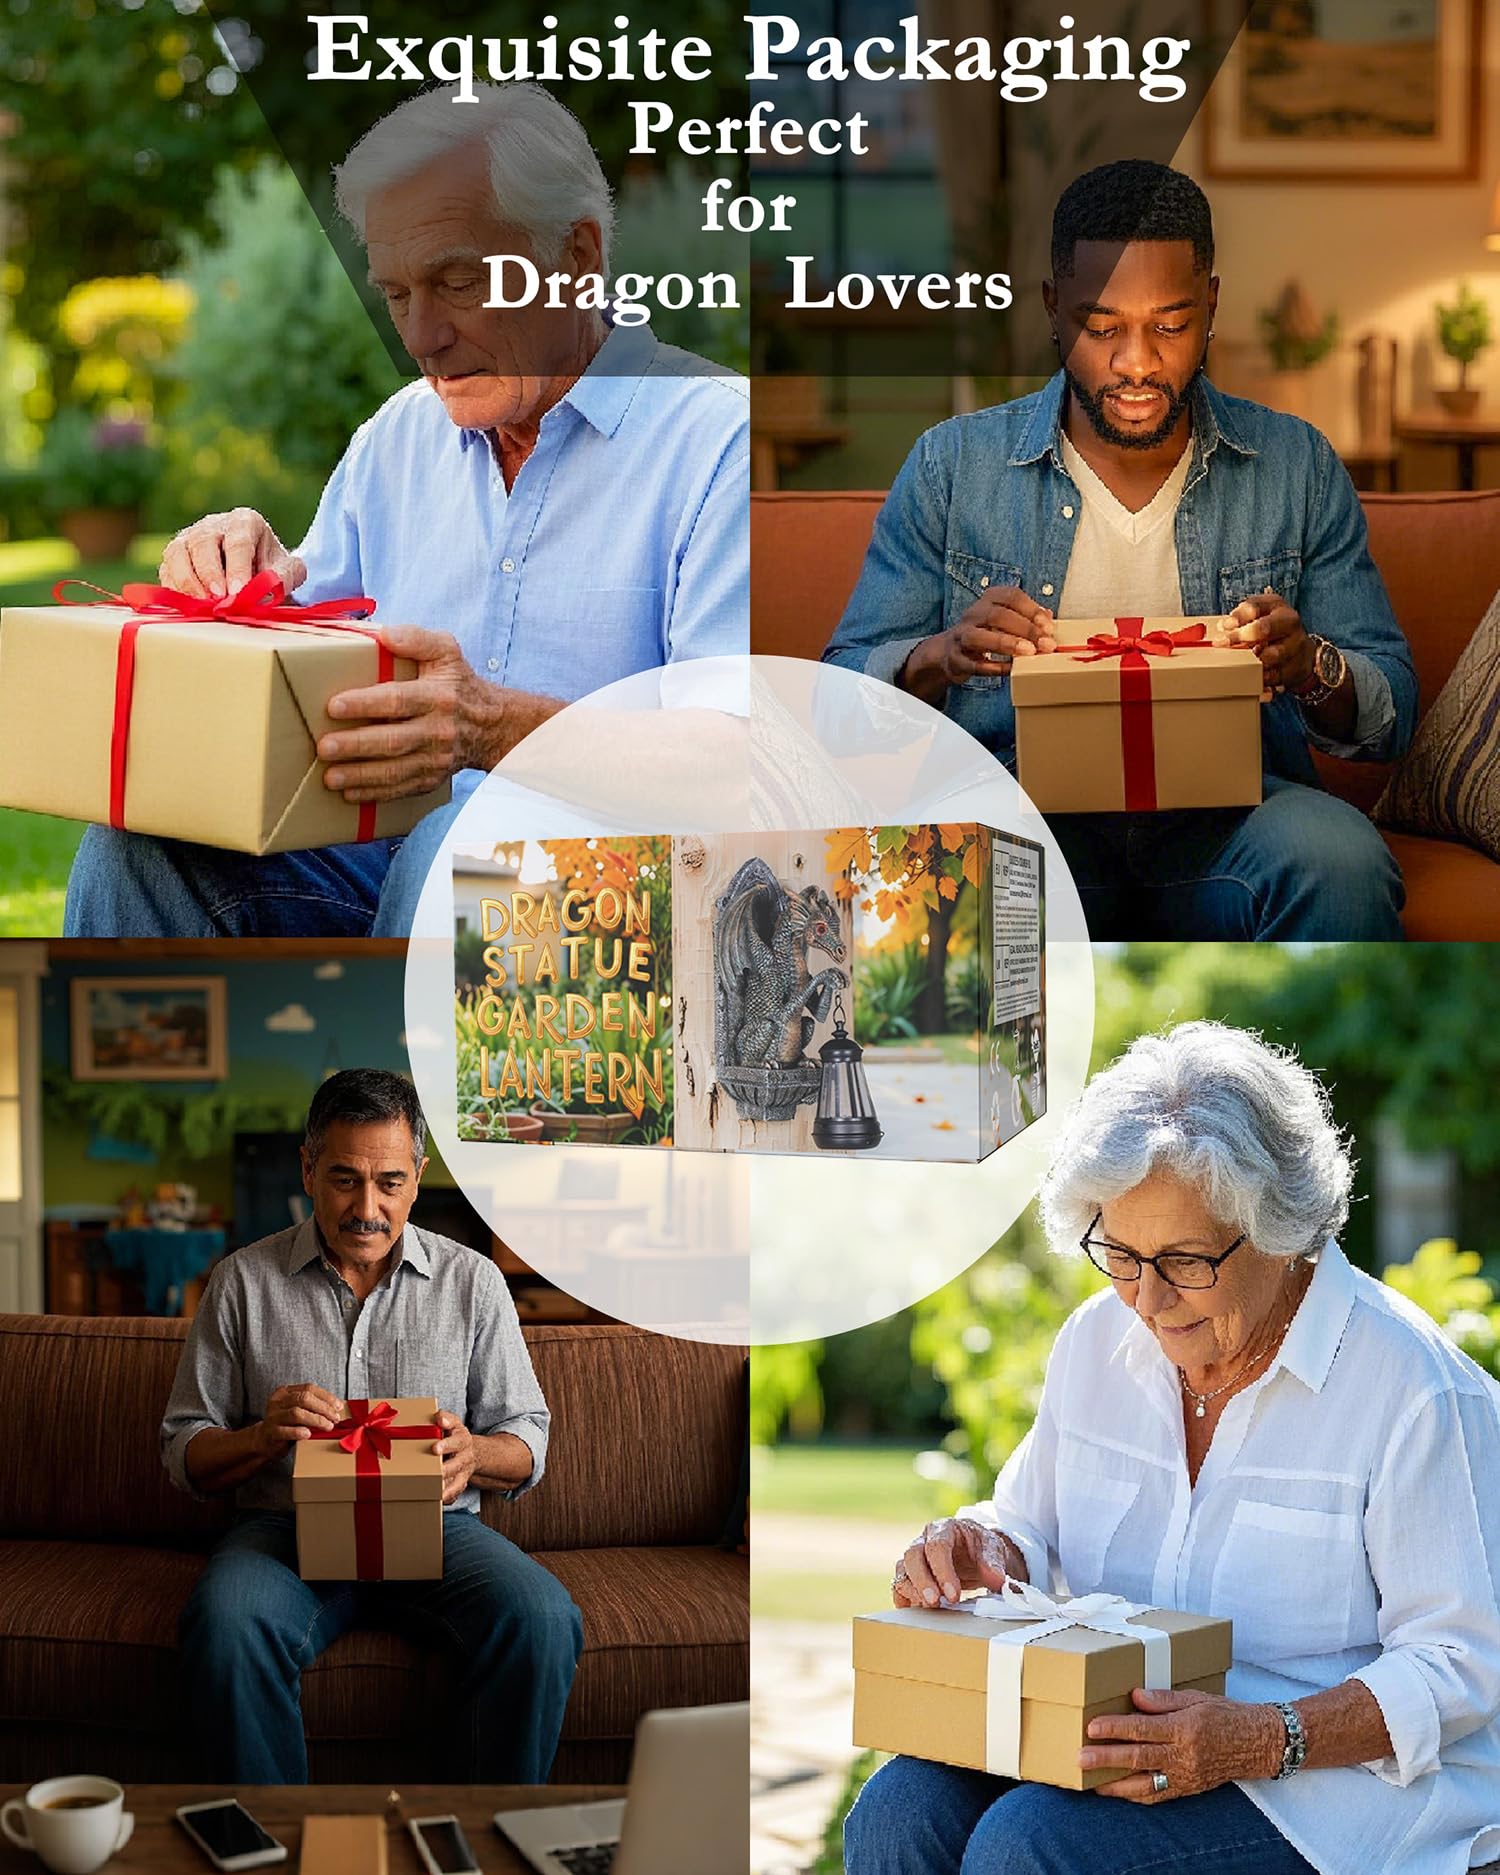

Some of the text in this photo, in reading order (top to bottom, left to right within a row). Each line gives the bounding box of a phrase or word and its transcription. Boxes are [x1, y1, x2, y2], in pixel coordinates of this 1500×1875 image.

[480, 887, 651, 942] DRAGON
[482, 936, 652, 988] STATUE
[476, 991, 656, 1045] GARDEN
[479, 1045, 665, 1111] LANTERN
